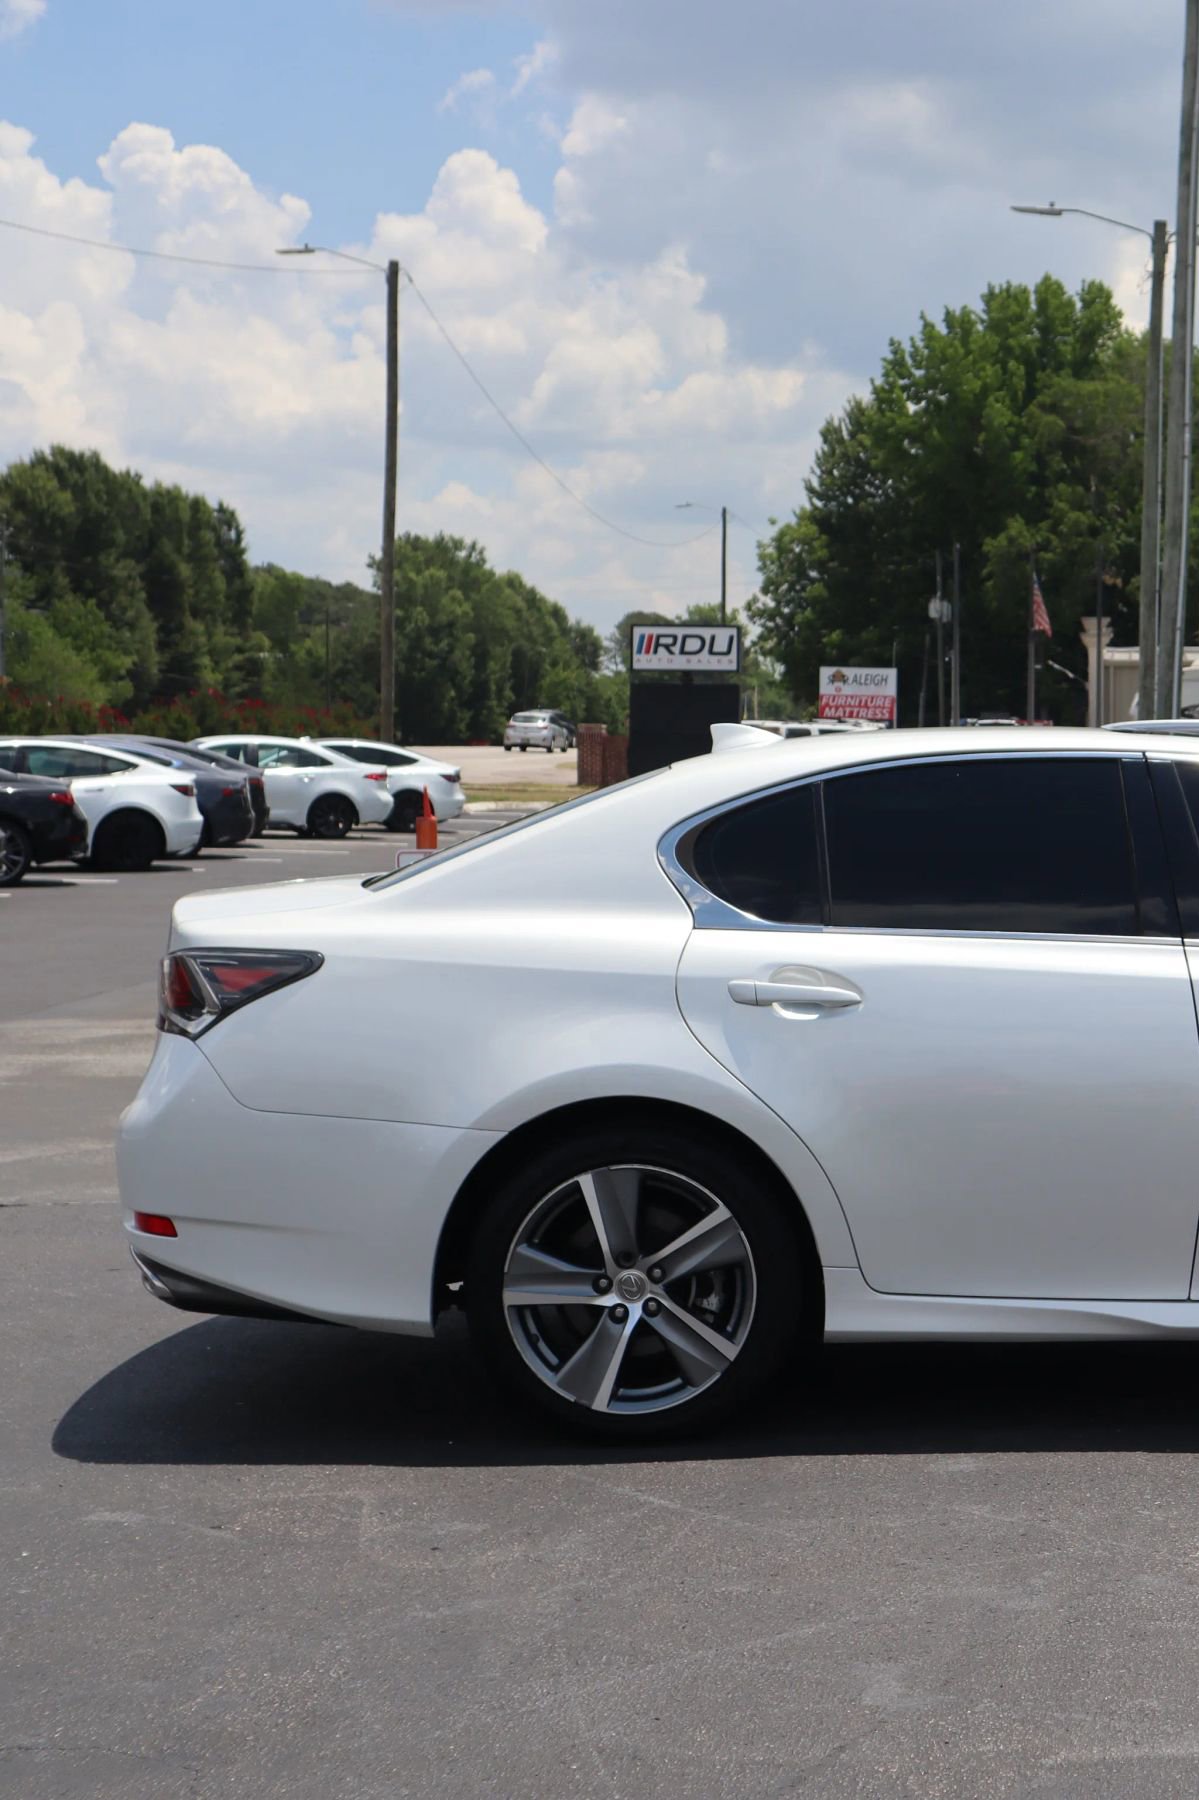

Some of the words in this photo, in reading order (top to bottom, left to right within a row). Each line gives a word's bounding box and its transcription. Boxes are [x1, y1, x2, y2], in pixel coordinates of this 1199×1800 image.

[653, 633, 734, 655] RDU
[821, 695, 892, 707] FURNITURE
[823, 706, 890, 720] MATTRESS
